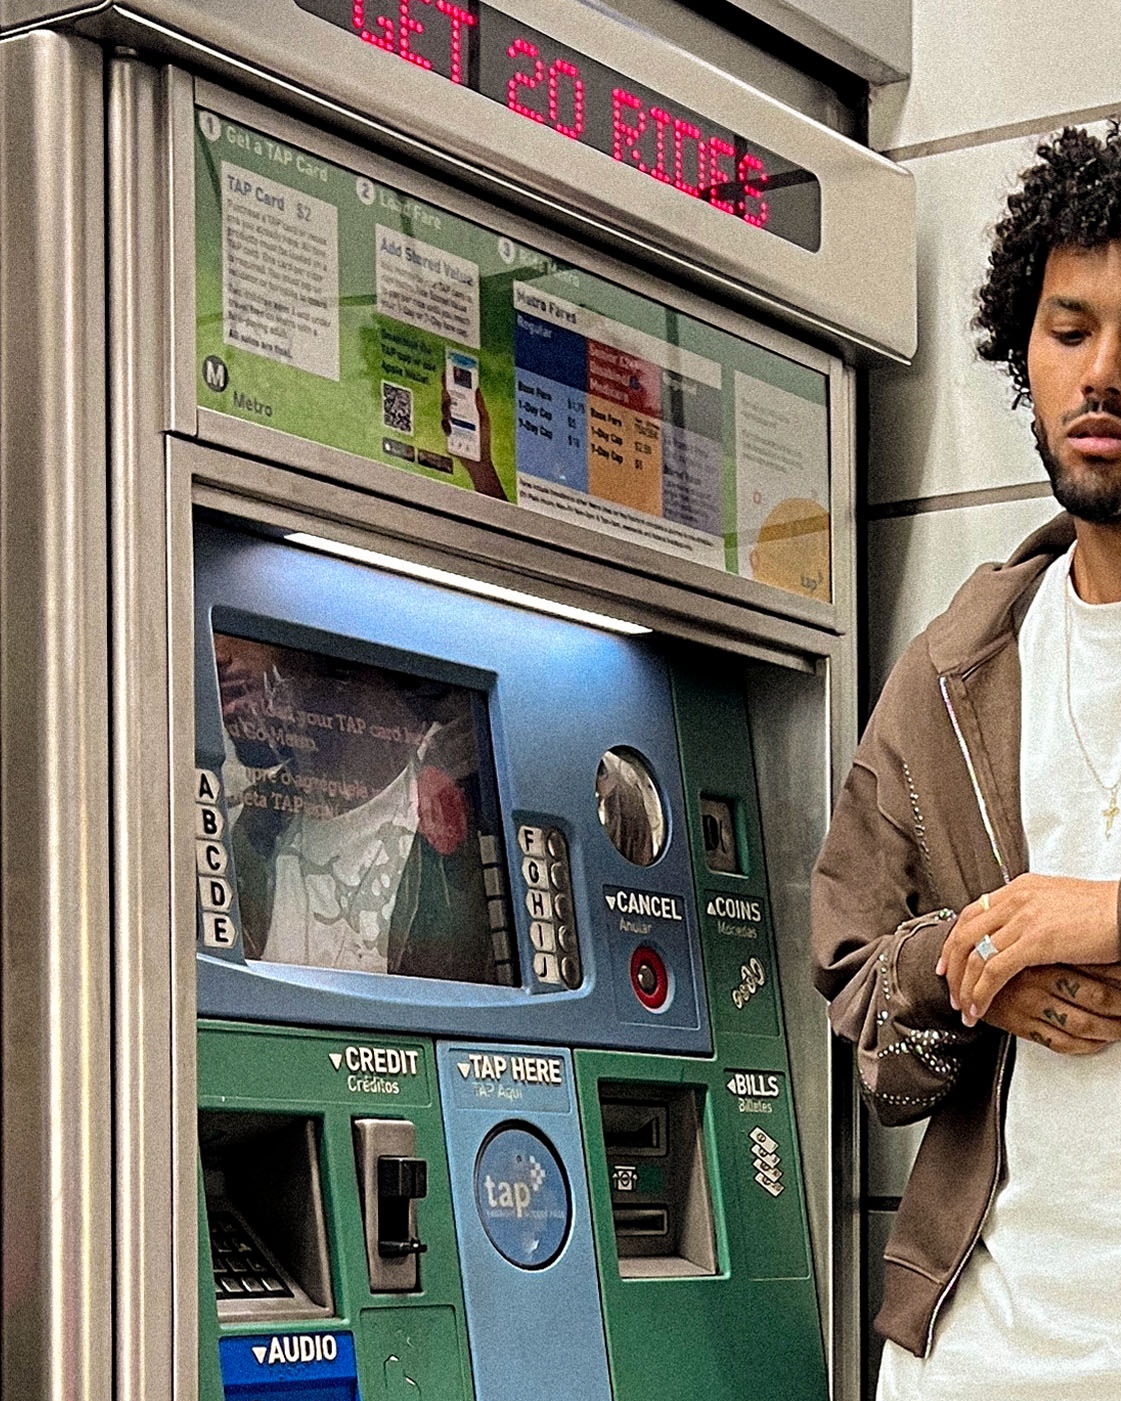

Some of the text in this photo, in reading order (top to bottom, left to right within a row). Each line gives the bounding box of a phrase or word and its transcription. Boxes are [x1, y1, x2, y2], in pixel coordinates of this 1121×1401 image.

[353, 0, 770, 229] GET 20 RIDES
[226, 125, 251, 150] Get
[254, 141, 262, 155] a
[265, 141, 293, 166] TAP
[296, 155, 329, 182] Card
[228, 174, 251, 196] TAP
[255, 186, 285, 212] Card
[361, 183, 370, 199] 2
[207, 360, 225, 388] M
[233, 391, 273, 417] Metro
[334, 713, 366, 735] TAP
[199, 773, 214, 799] A
[272, 792, 304, 813] TAP
[202, 808, 217, 834] B
[524, 829, 534, 851] F
[206, 845, 220, 870] C
[211, 881, 225, 906] D
[532, 893, 545, 917] H
[616, 890, 683, 921] CANCEL
[715, 897, 761, 922] COINS
[214, 918, 229, 943] E
[539, 957, 547, 978] J
[345, 1046, 419, 1075] CREDIT
[469, 1054, 563, 1083] TAP HERE
[735, 1074, 779, 1097] BILLS
[484, 1175, 531, 1218] tap
[268, 1335, 338, 1364] AUDIO
